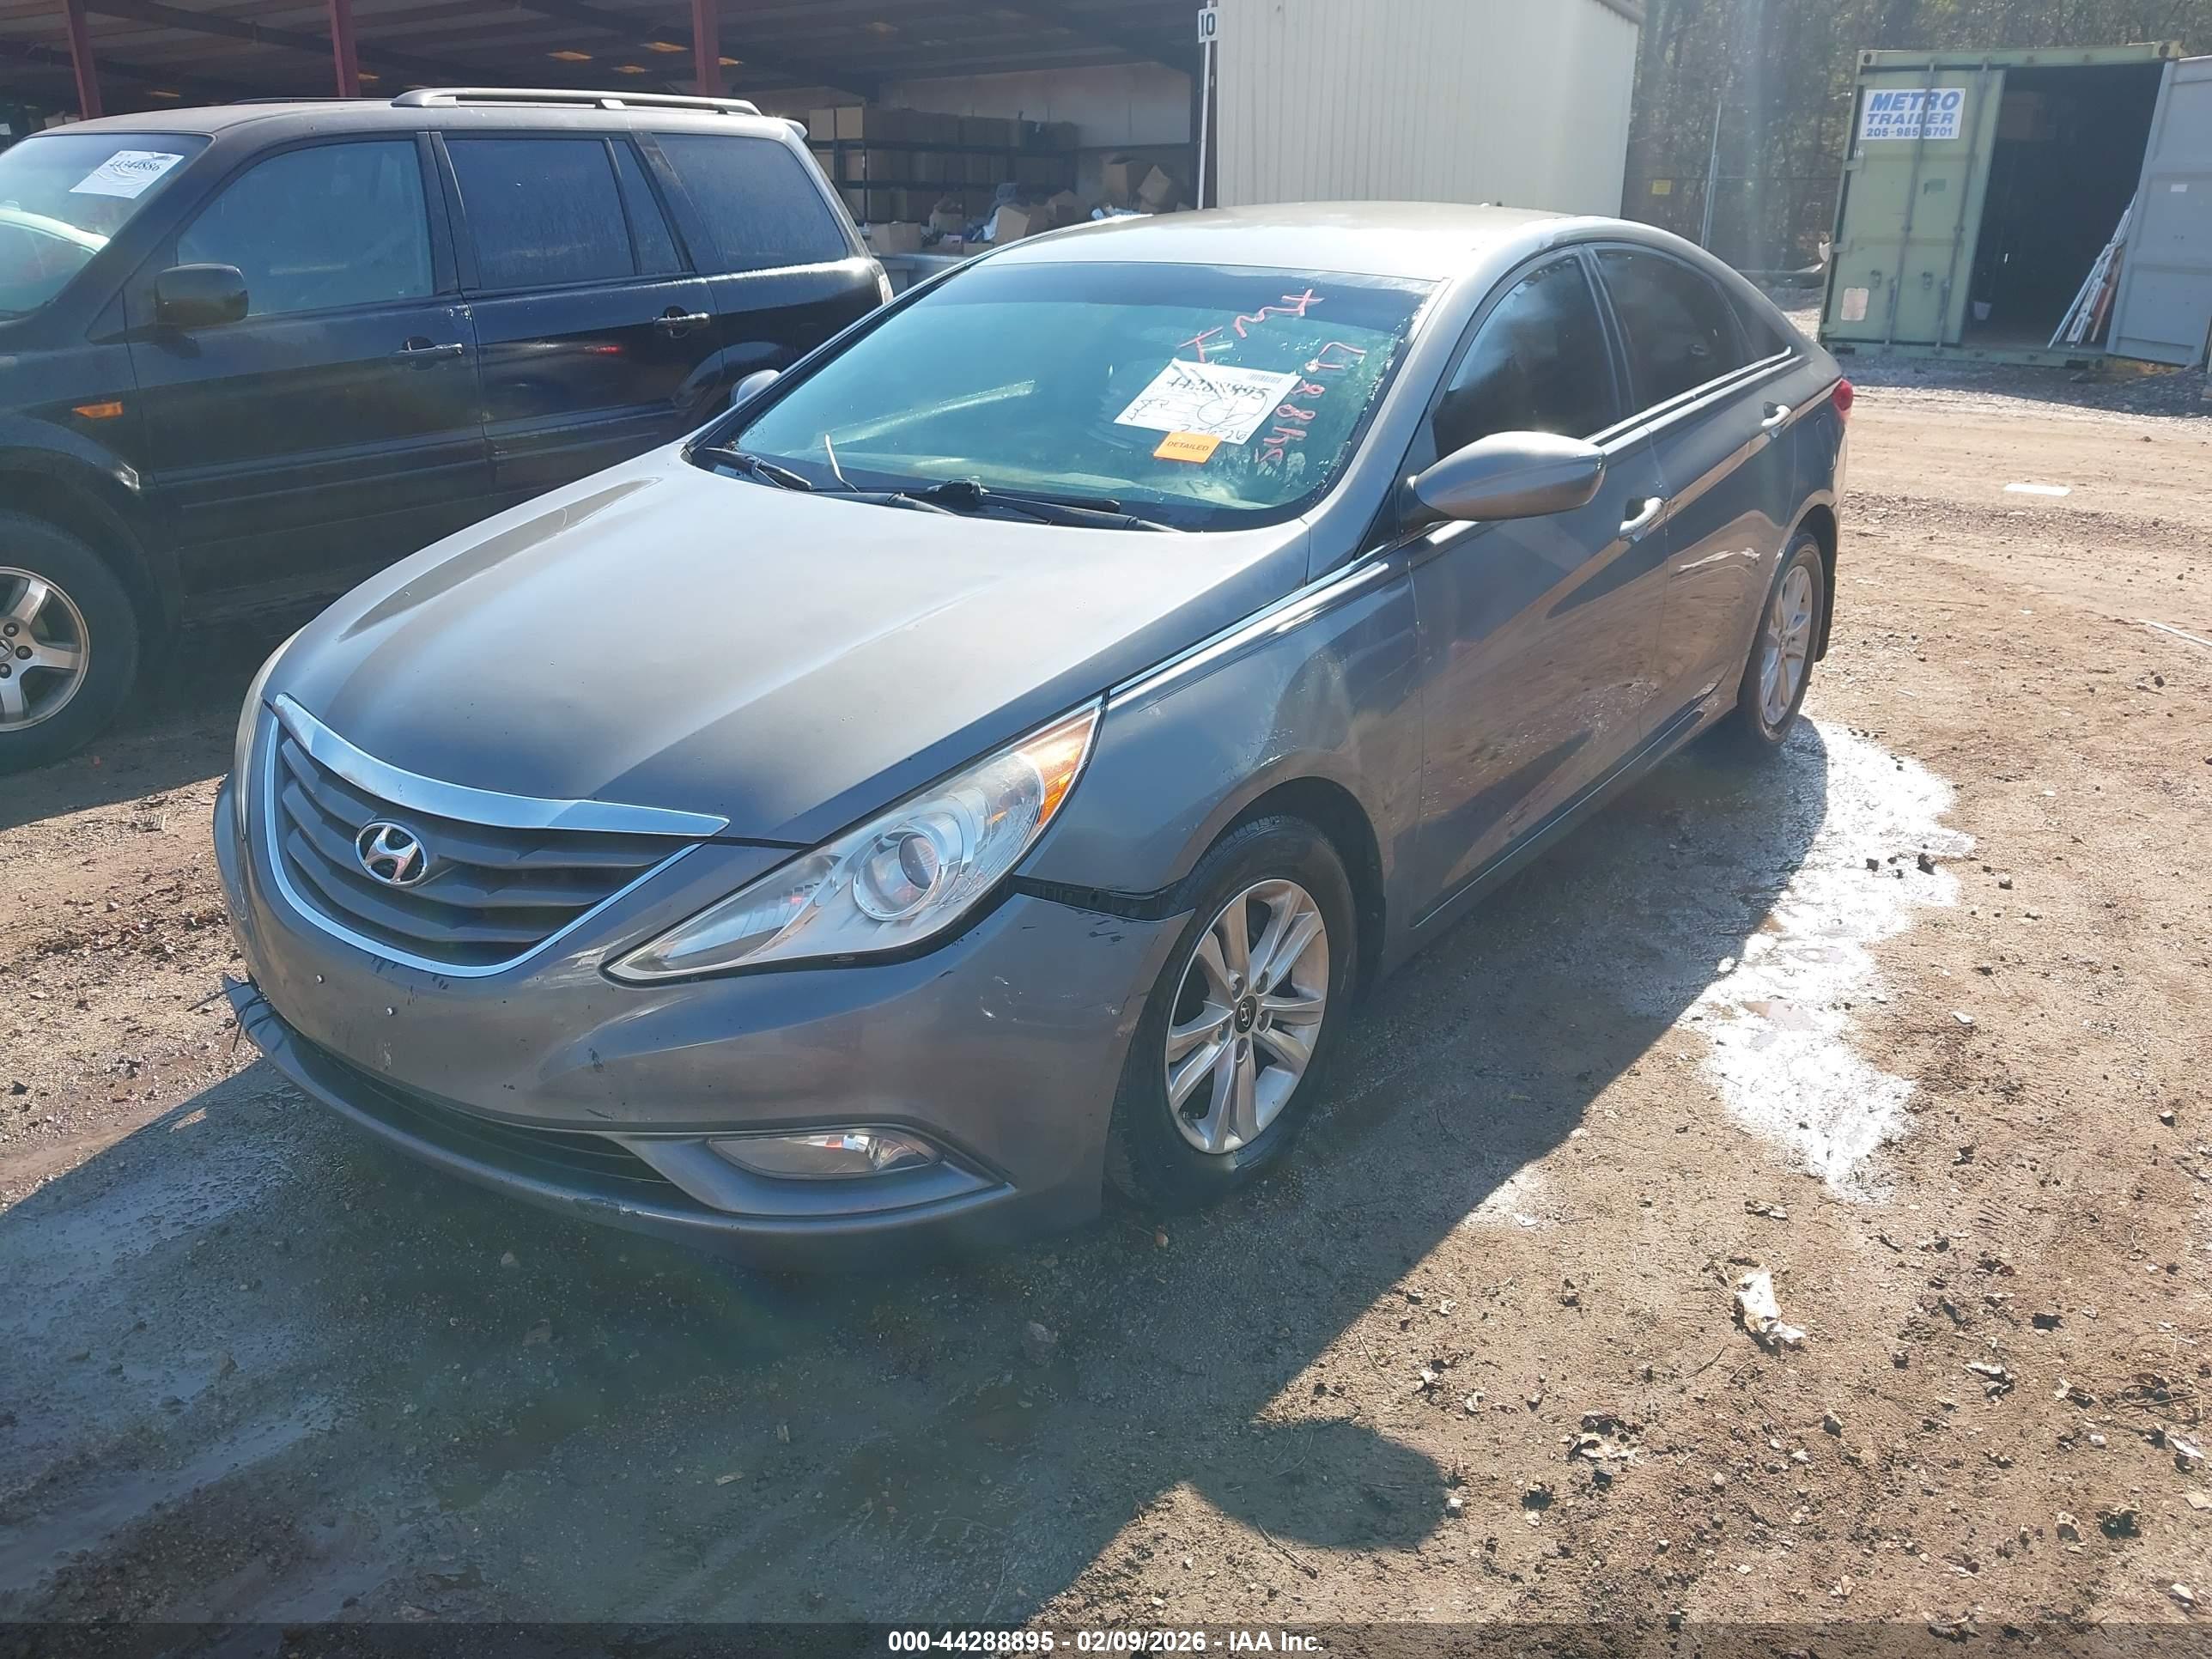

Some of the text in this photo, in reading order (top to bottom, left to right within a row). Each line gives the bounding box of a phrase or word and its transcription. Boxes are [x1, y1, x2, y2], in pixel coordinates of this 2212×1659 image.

[1201, 13, 1216, 36] 10
[1869, 91, 1960, 112] METRO
[1867, 112, 1955, 125] TRAILER
[1865, 126, 1954, 137] 205-9858701
[1166, 440, 1209, 452] DETAILED
